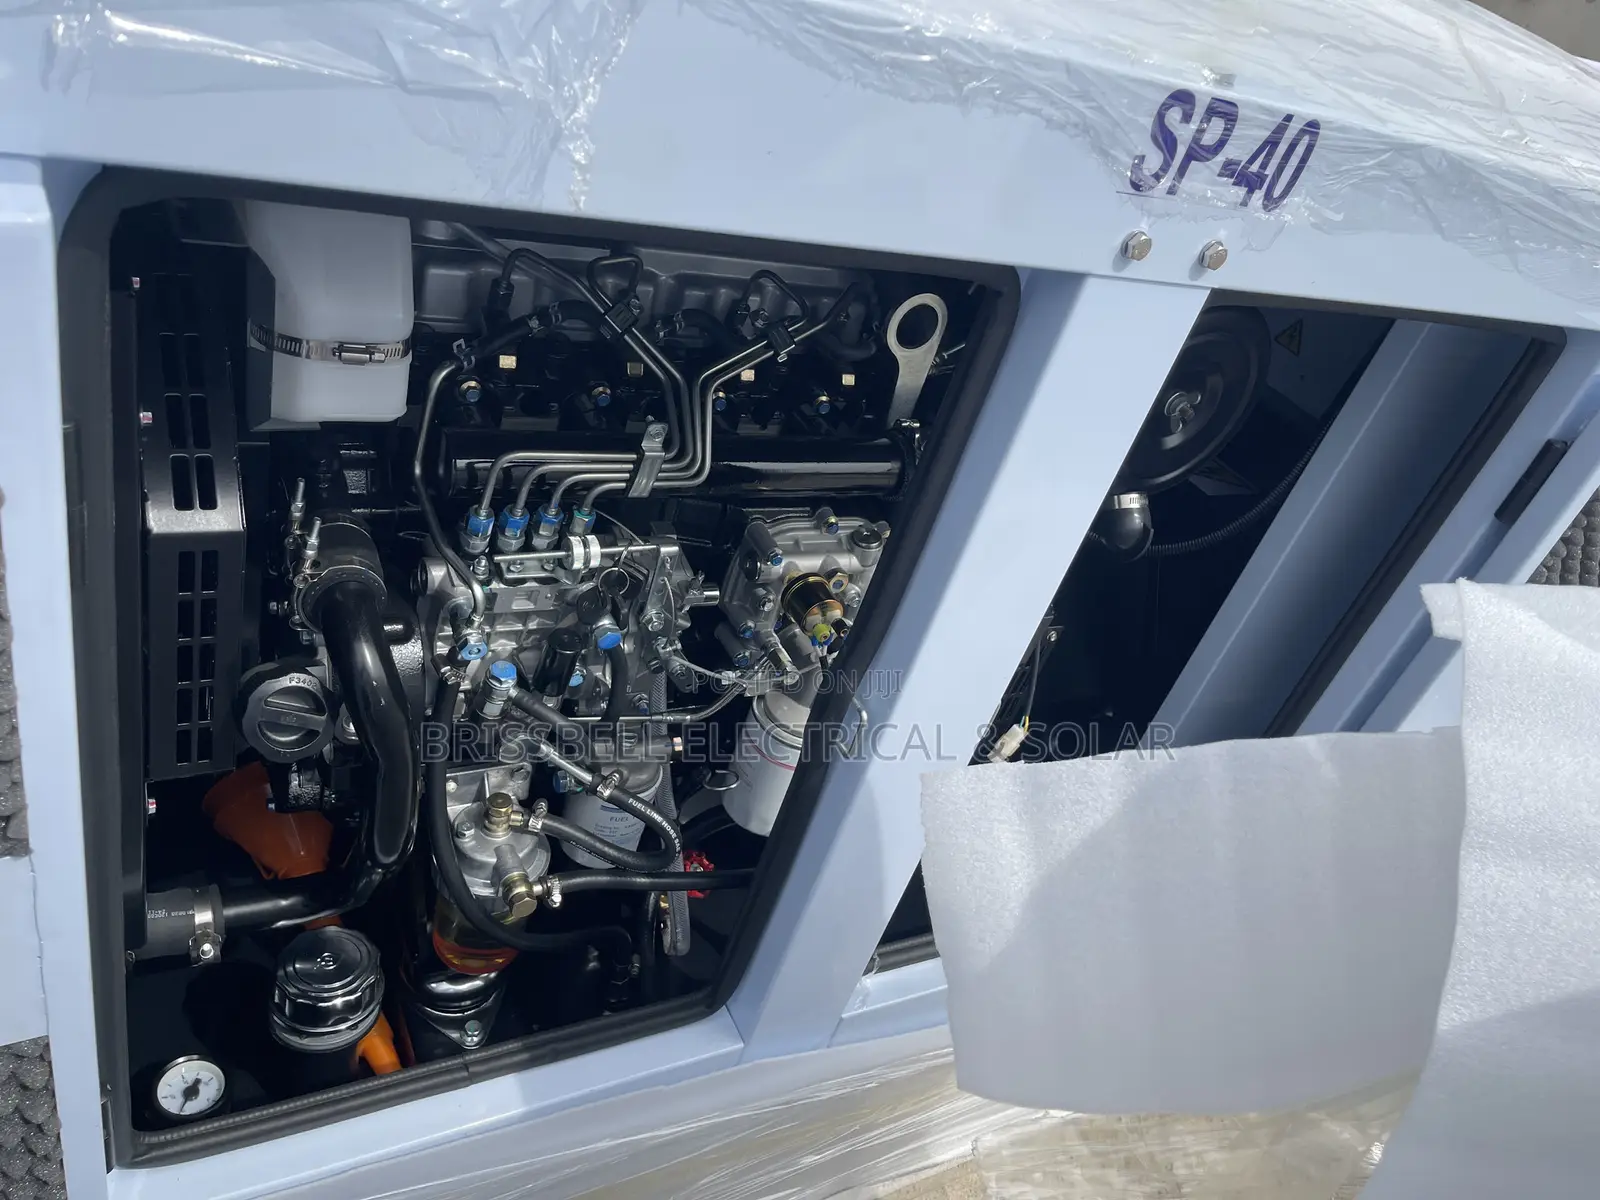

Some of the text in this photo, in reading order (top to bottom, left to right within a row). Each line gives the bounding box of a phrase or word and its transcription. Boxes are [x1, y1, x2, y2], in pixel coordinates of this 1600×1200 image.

[1129, 88, 1321, 213] SP-40
[628, 798, 646, 813] FUEL
[646, 807, 662, 823] LINE
[662, 820, 677, 840] HOSE
